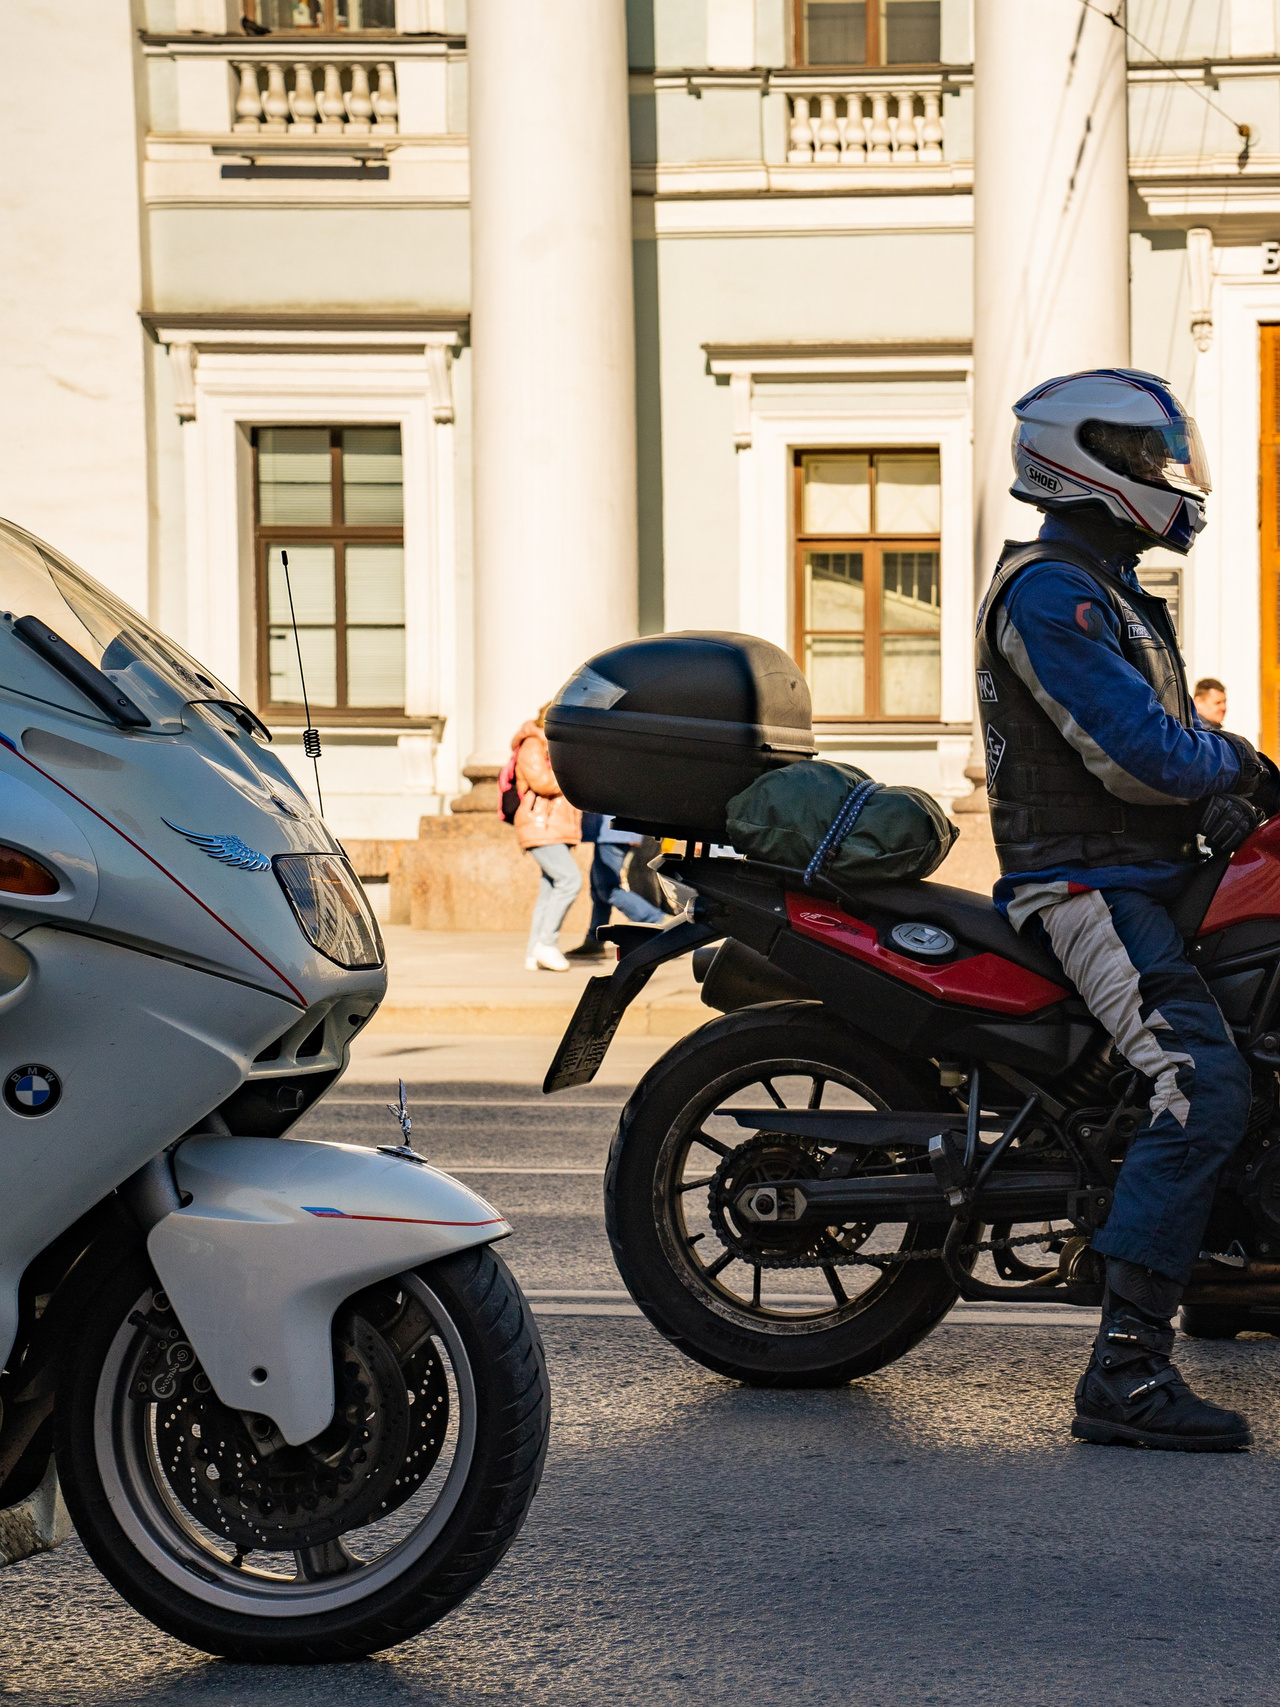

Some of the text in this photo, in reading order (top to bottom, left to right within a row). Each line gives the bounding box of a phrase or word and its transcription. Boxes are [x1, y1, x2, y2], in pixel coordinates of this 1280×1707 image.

[1028, 467, 1058, 491] SHOEI
[10, 1067, 56, 1083] BMW
[157, 1362, 180, 1393] brembo
